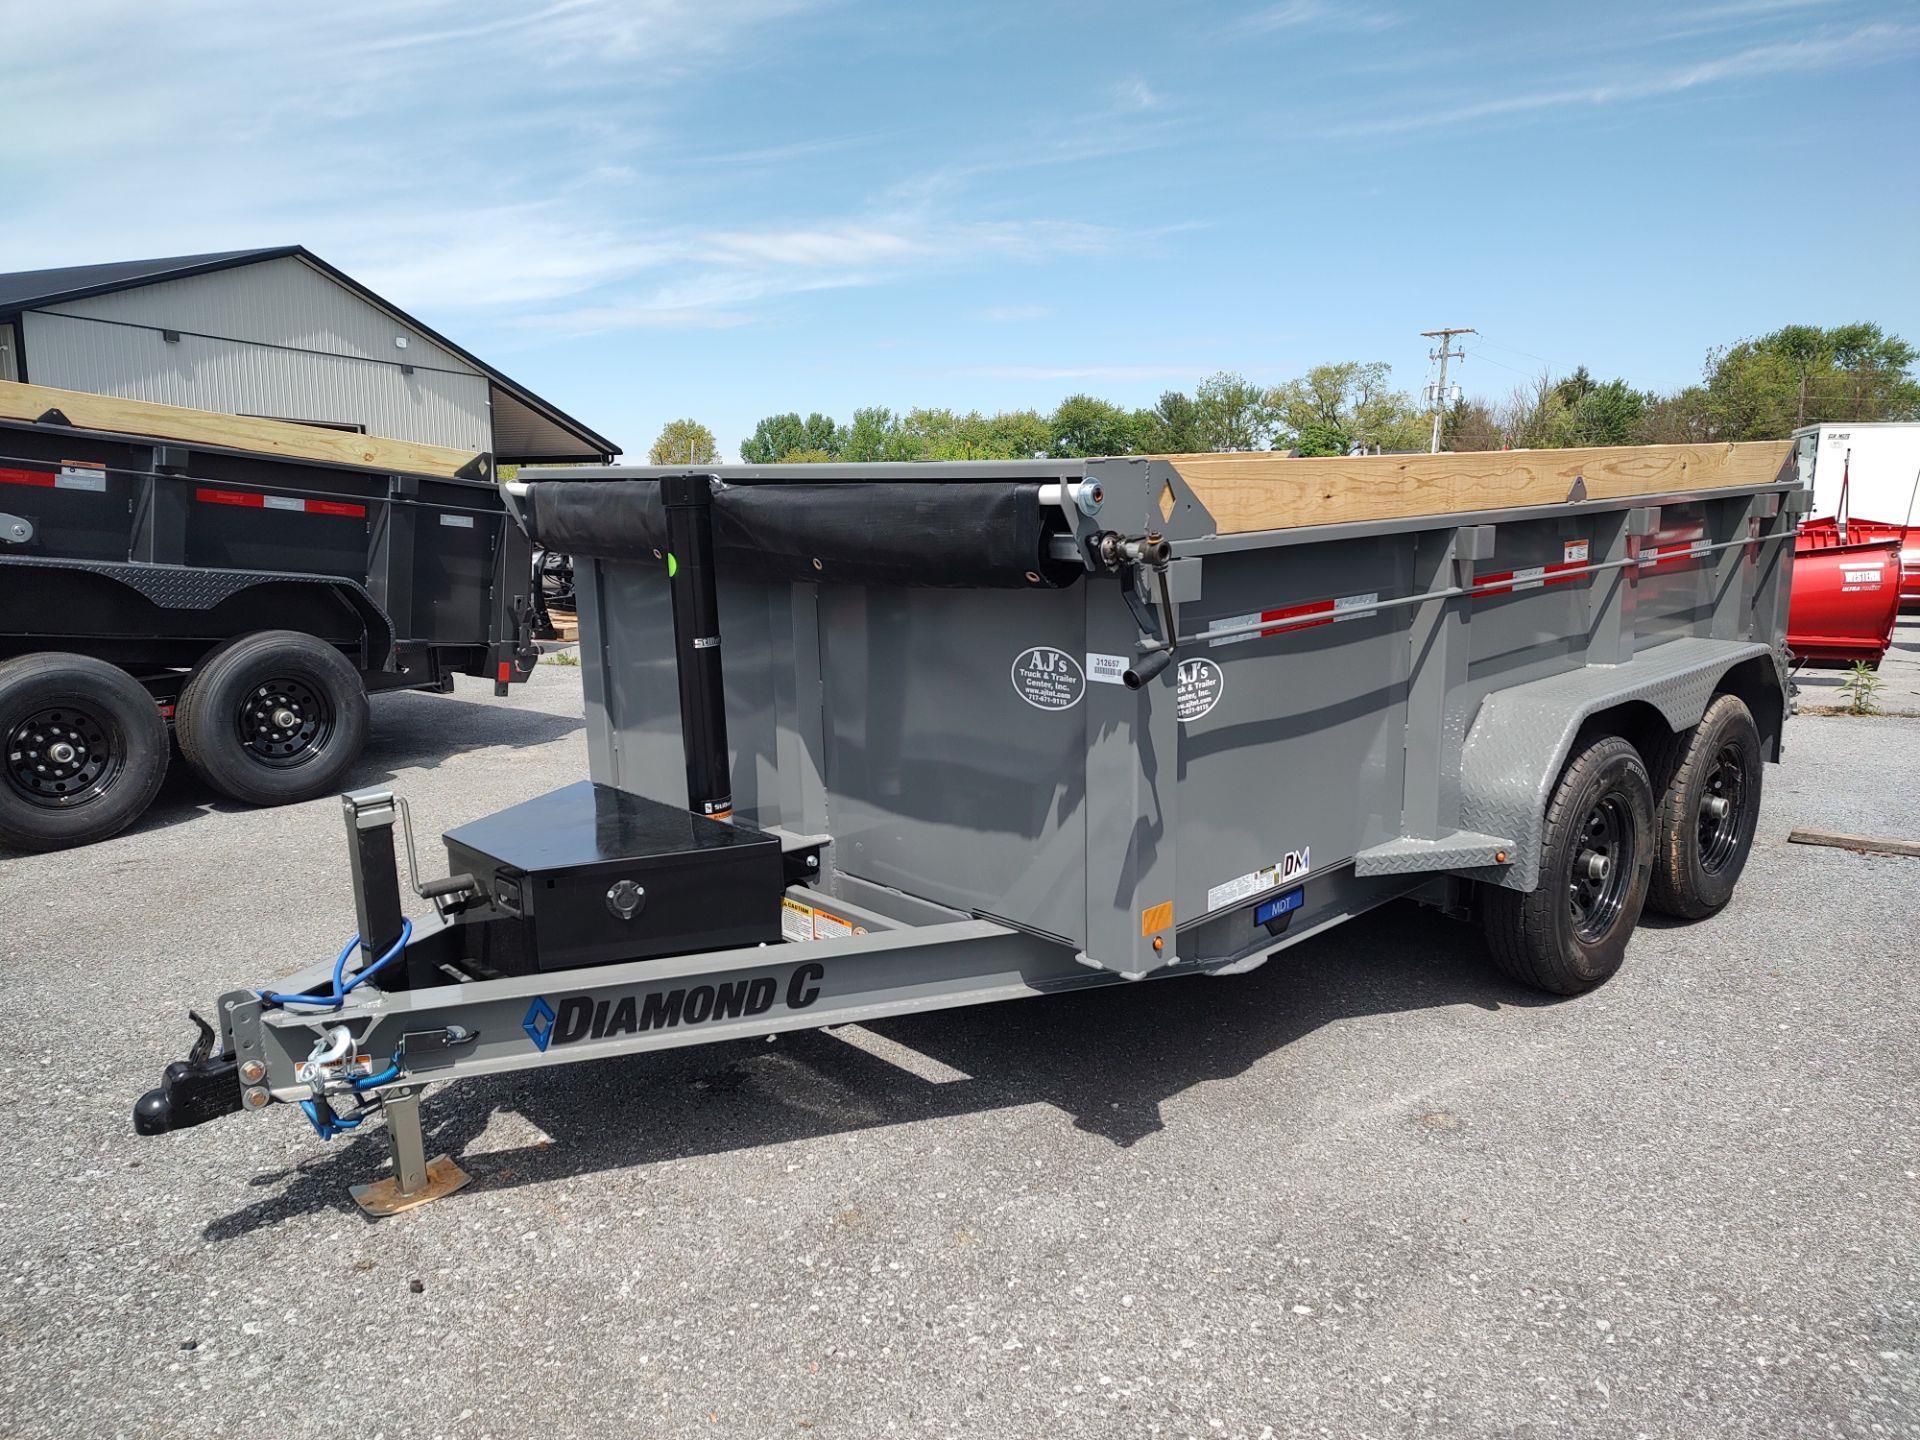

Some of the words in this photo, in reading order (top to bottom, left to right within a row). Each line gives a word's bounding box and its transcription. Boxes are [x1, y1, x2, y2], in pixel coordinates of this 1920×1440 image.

[1029, 651, 1067, 672] AJ's
[1019, 668, 1041, 678] Truck
[1051, 673, 1076, 683] Trailer
[1177, 662, 1208, 685] AJ's
[1026, 679, 1053, 690] Center,
[1055, 683, 1069, 691] Inc.
[1195, 679, 1216, 689] Trailer
[1177, 692, 1197, 702] enter,
[1284, 848, 1309, 876] DM
[787, 902, 809, 914] CAUTION
[1271, 896, 1291, 916] MDT
[550, 976, 778, 1047] DIAMOND
[785, 963, 825, 1010] C
